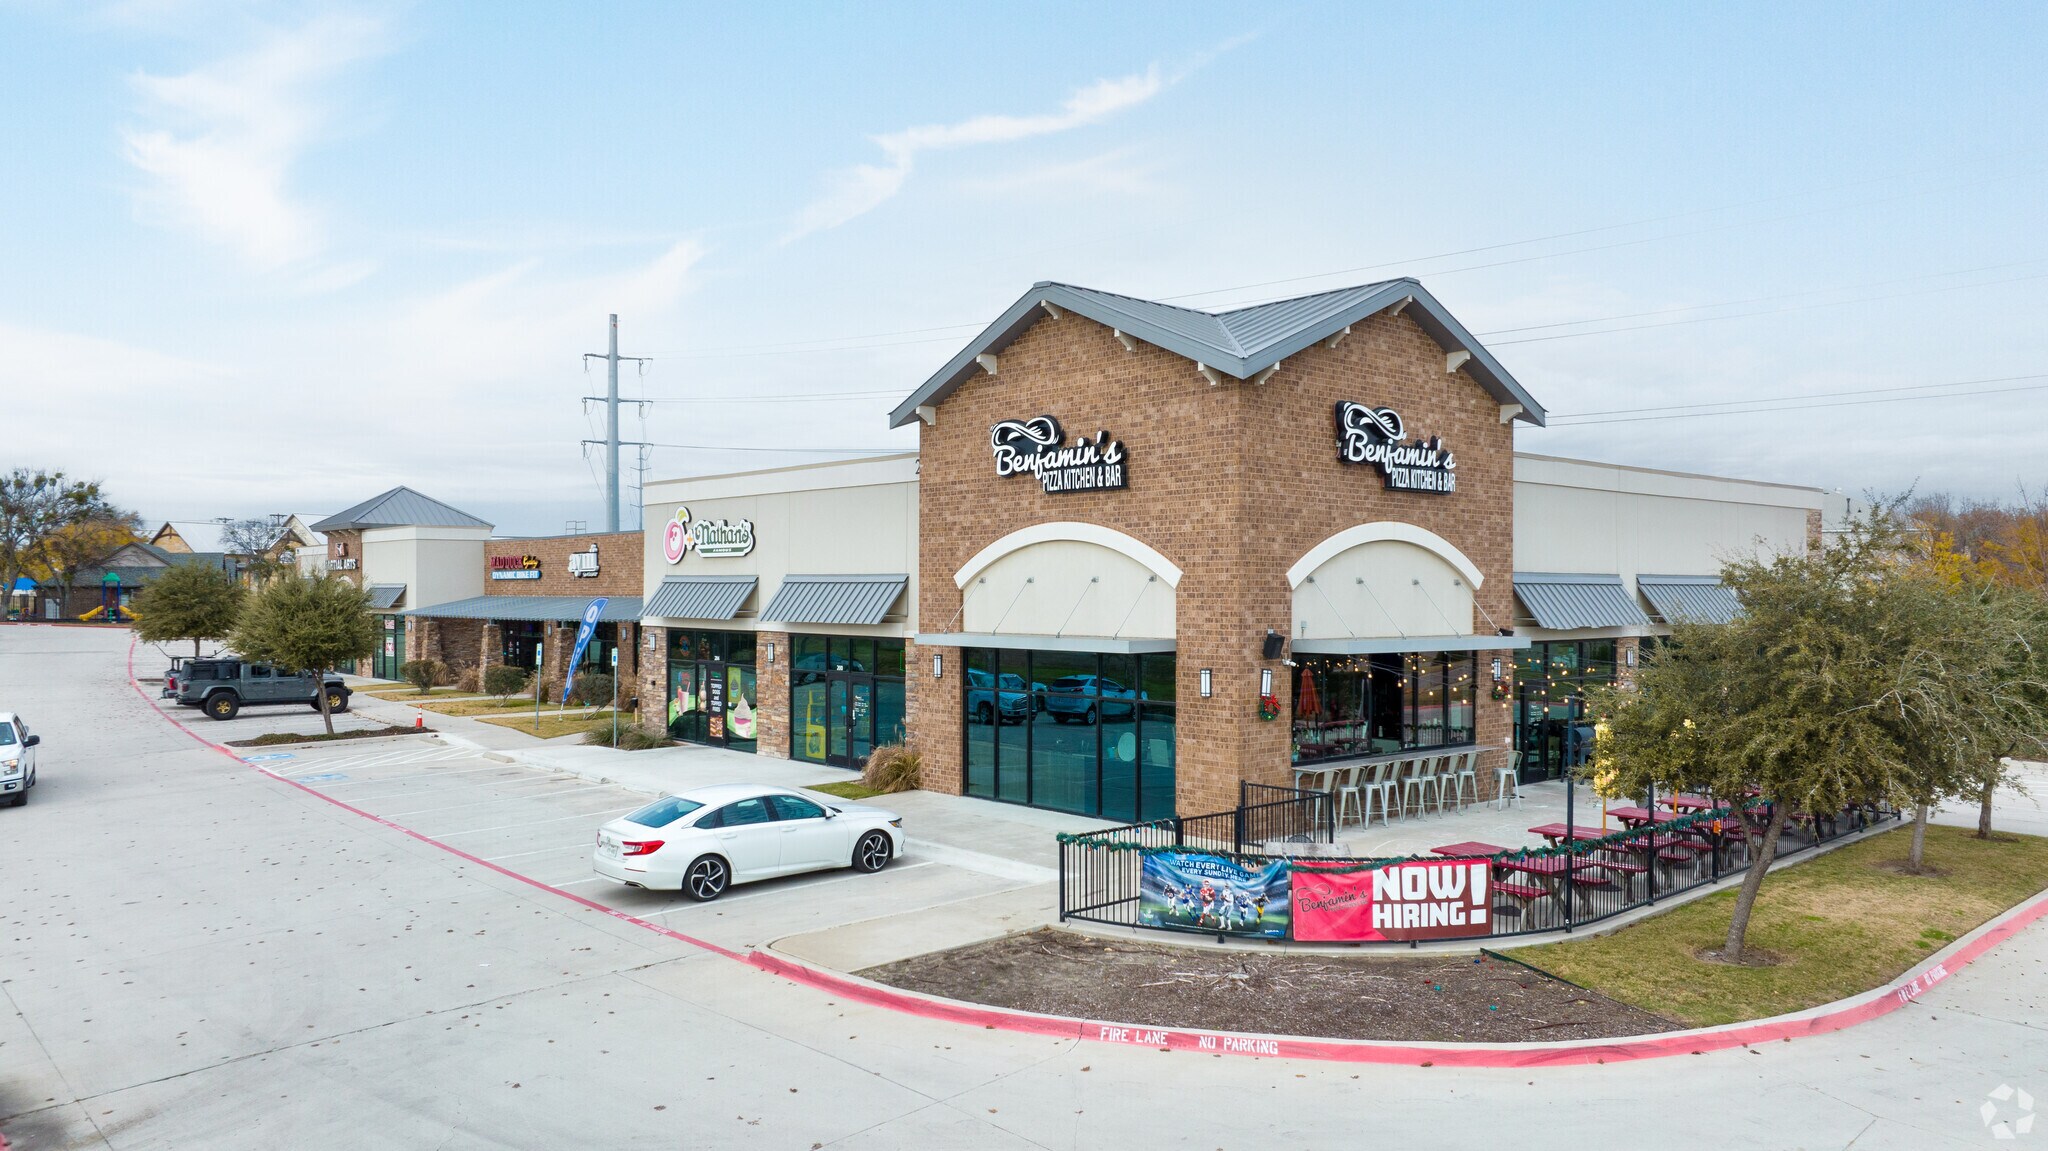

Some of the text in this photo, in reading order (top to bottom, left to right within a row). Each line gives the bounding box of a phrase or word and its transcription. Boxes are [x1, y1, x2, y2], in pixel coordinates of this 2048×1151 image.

[993, 431, 1121, 479] Benjamin's
[1346, 429, 1456, 473] Benjamin's
[1043, 464, 1122, 492] PIZZA KITCHEN & BAR
[1391, 467, 1456, 492] PIZZA KITCHEN & BAR
[695, 523, 749, 546] Nathan's
[492, 571, 539, 579] DYNAMIC BIKE FIT
[1169, 859, 1194, 868] WATCH
[1195, 861, 1219, 870] EVERY
[1221, 864, 1237, 875] LIVE
[1181, 867, 1202, 875] EVERY
[1373, 865, 1466, 901] NOW
[1301, 885, 1368, 912] Benjamin's
[1373, 902, 1466, 929] HIRING
[1100, 1027, 1278, 1055] FIRE LANE NO PARKING
